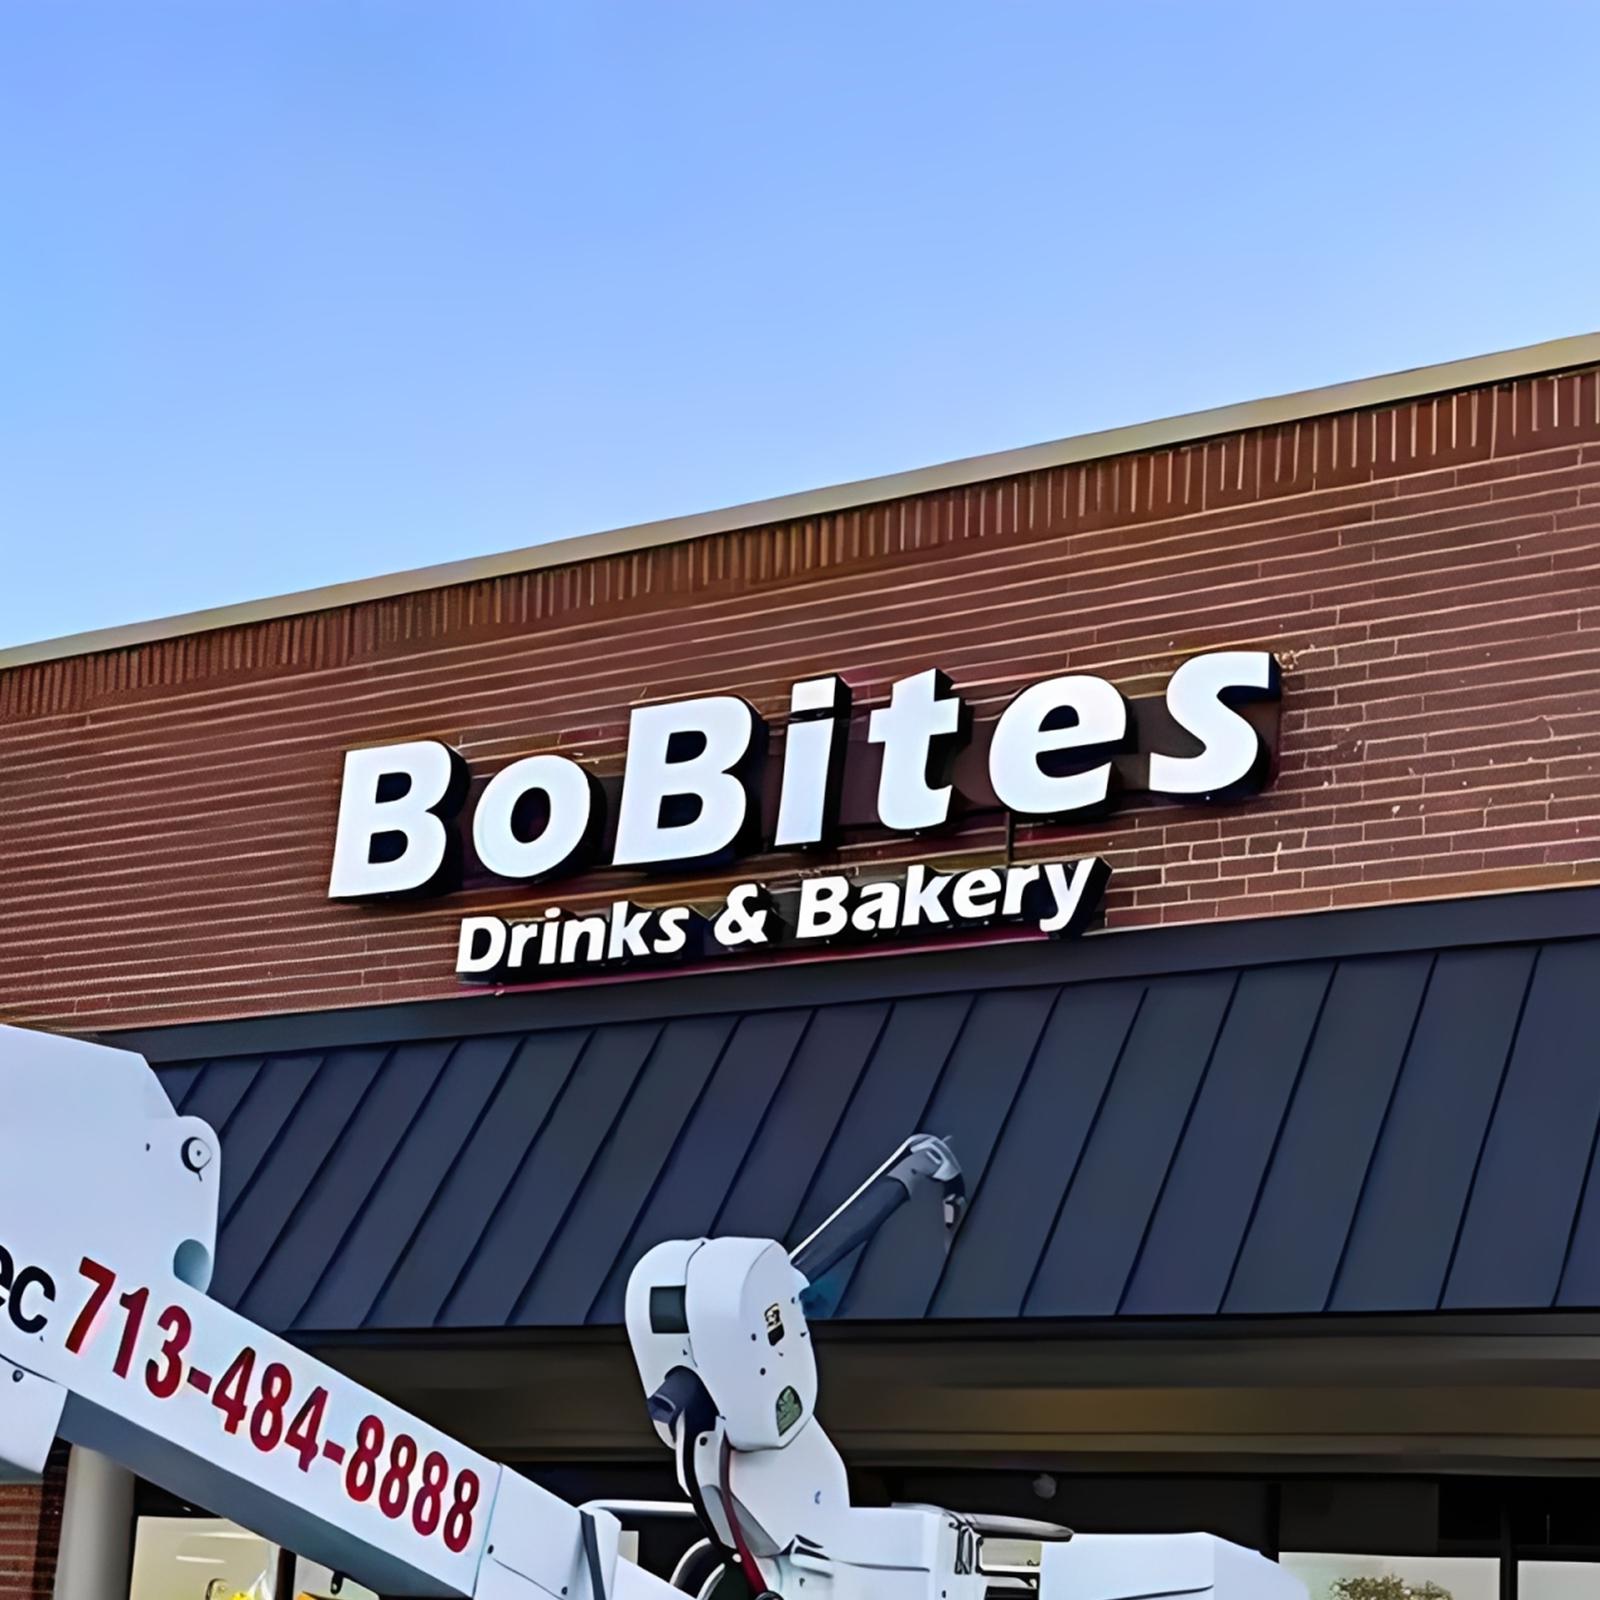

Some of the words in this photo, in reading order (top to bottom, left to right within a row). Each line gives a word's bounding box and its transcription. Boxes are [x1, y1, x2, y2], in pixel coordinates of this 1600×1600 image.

[328, 651, 1272, 898] BoBites
[455, 901, 690, 973] Drinks
[713, 883, 769, 946] &
[796, 857, 1098, 939] Bakery
[65, 1256, 480, 1553] 713-484-8888
